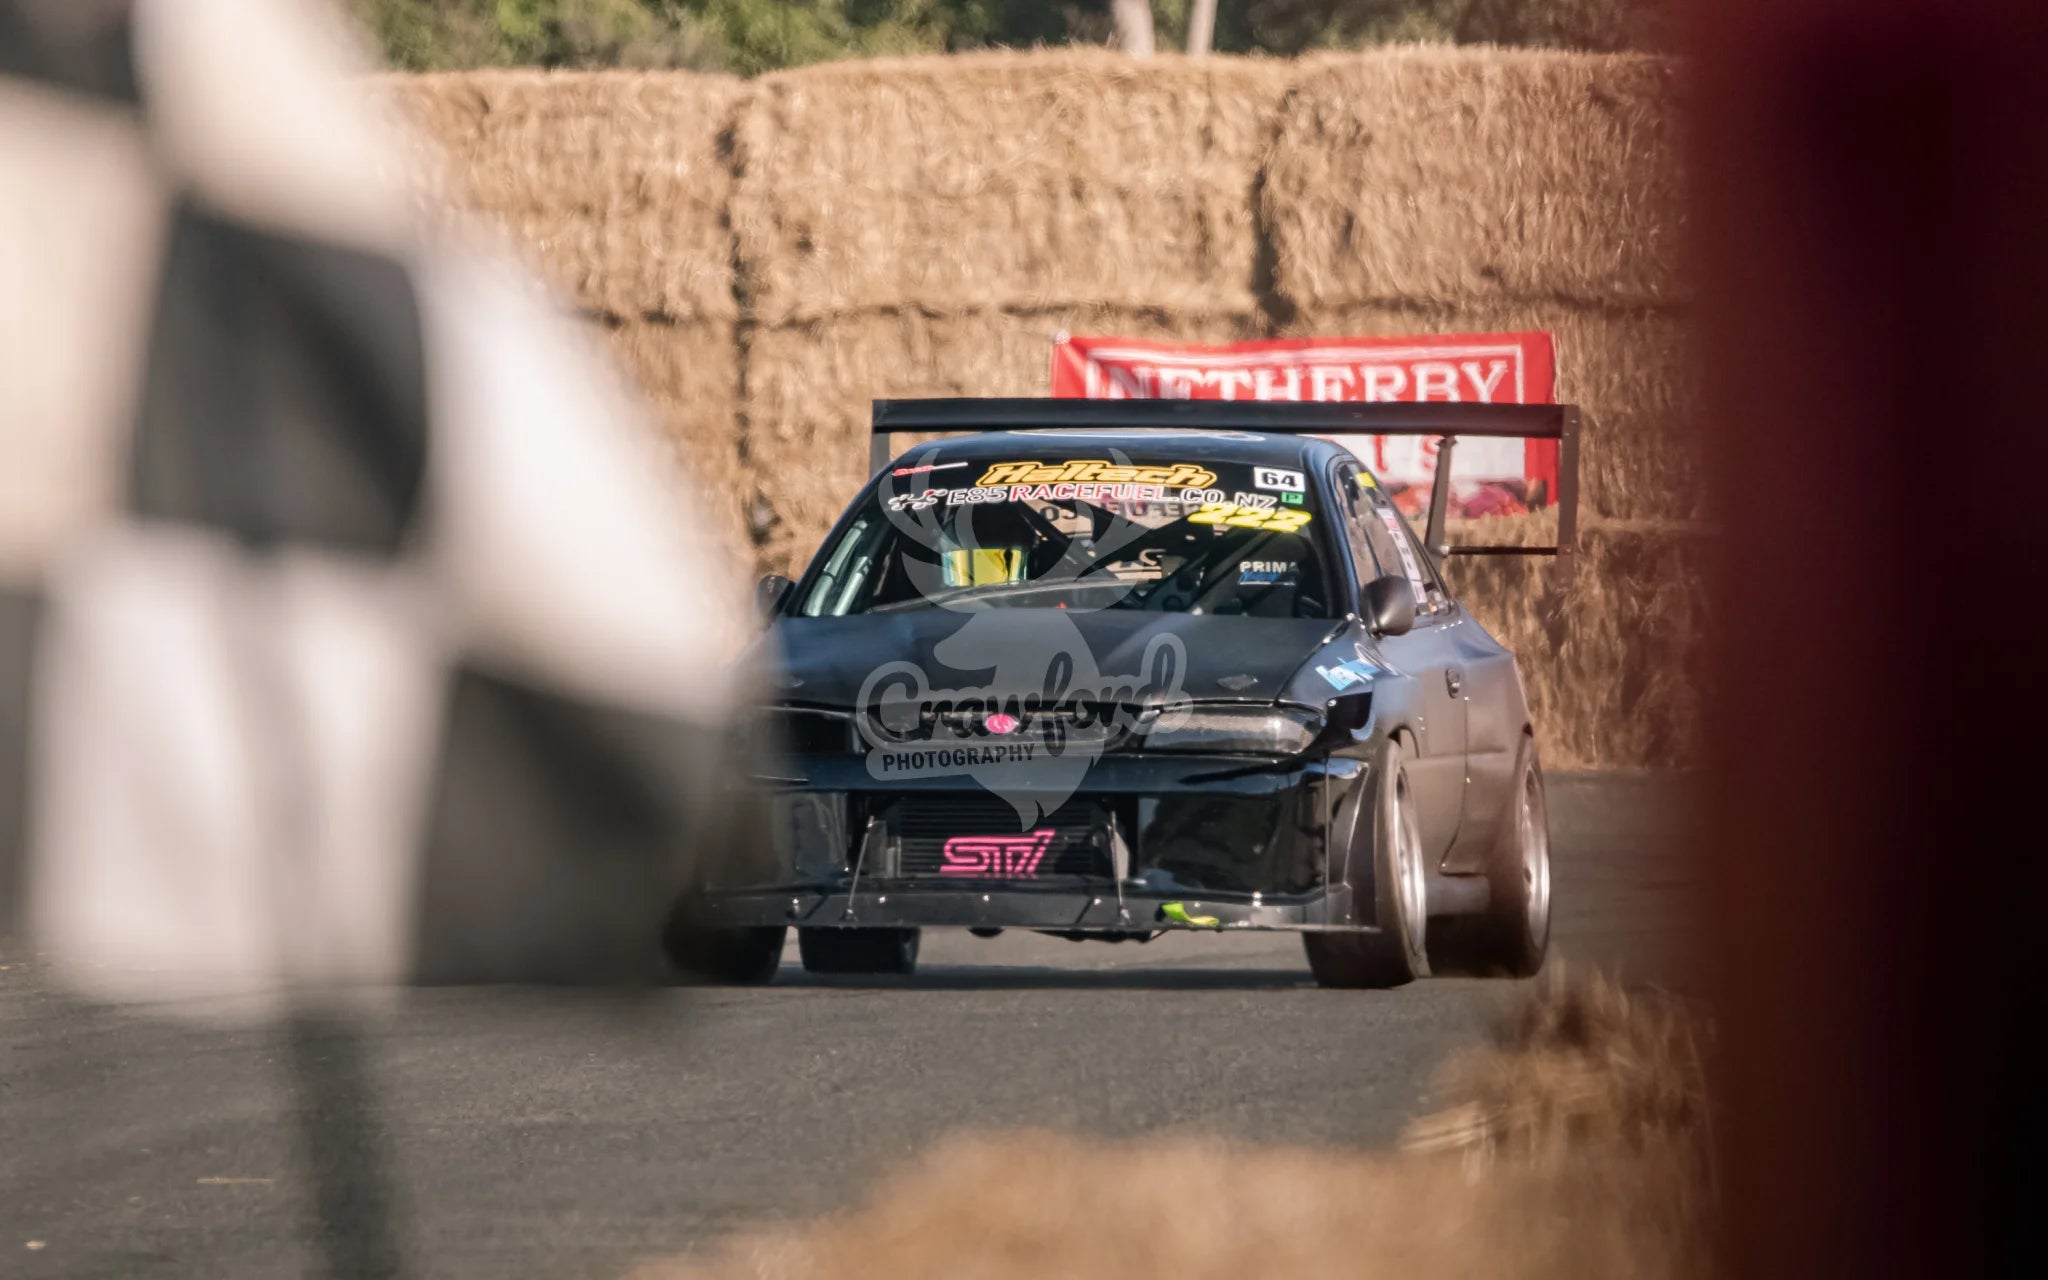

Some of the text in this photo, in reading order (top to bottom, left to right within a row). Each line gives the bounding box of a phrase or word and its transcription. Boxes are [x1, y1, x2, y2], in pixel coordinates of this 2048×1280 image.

[978, 461, 1215, 488] Haltech
[1261, 471, 1298, 488] 64
[1188, 503, 1313, 533] 222
